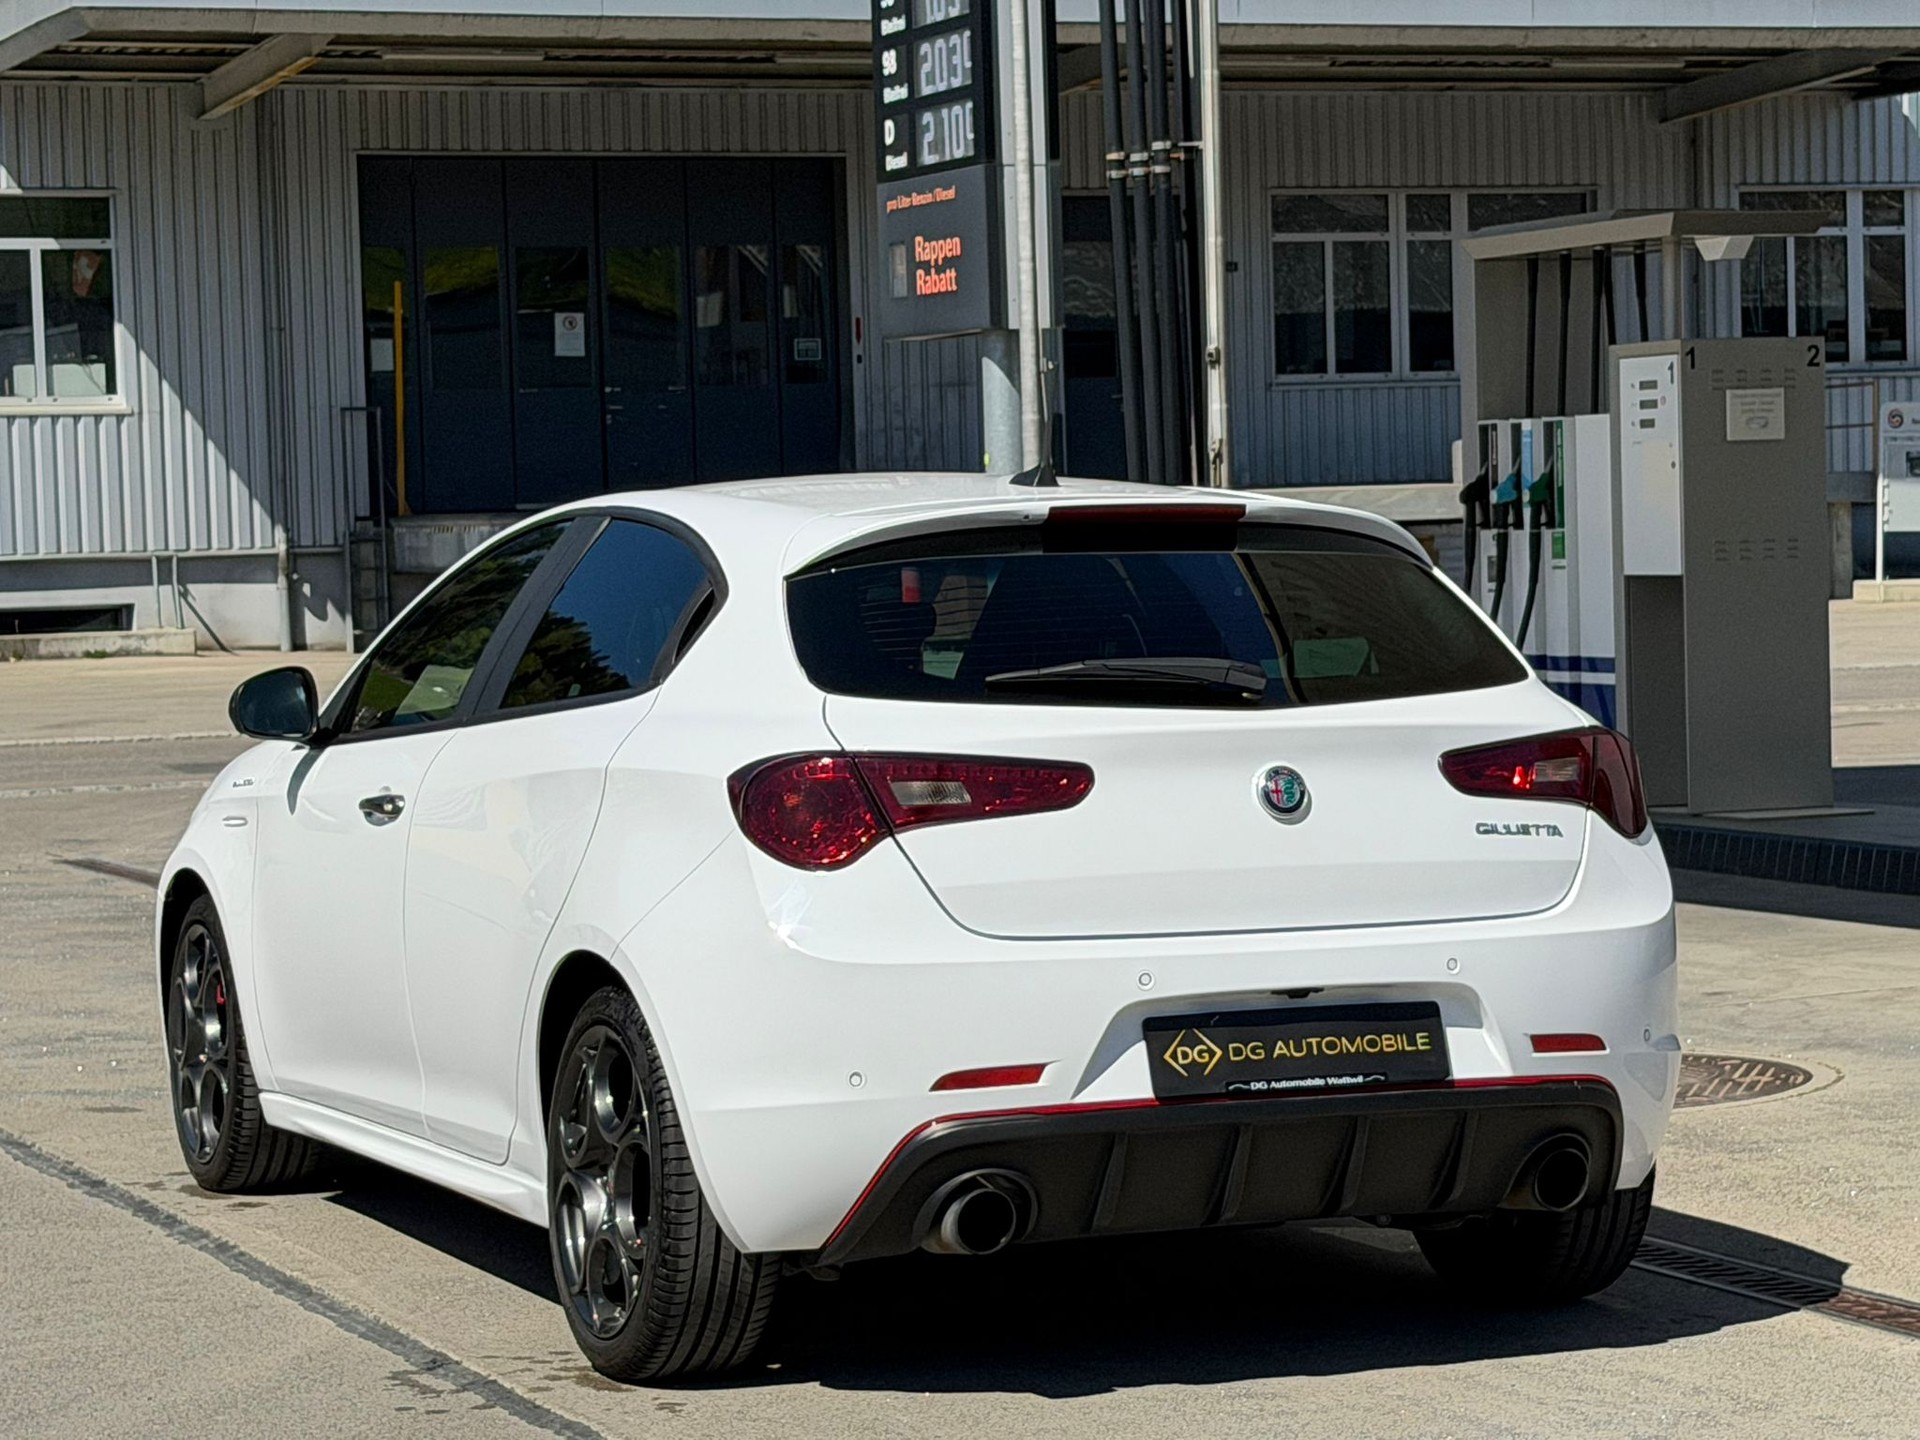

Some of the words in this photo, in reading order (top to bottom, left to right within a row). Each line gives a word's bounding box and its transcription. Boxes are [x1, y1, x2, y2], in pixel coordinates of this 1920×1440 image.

[882, 49, 897, 76] 98
[884, 119, 896, 146] D
[914, 235, 961, 266] Rappen
[916, 267, 958, 295] Rabatt
[1685, 346, 1696, 370] 1
[1806, 344, 1821, 367] 2
[1667, 361, 1675, 385] 1
[1228, 1042, 1266, 1061] DG
[1273, 1032, 1432, 1059] AUTOMOBILE
[1250, 1082, 1268, 1091] DG
[1270, 1077, 1326, 1089] Automobile
